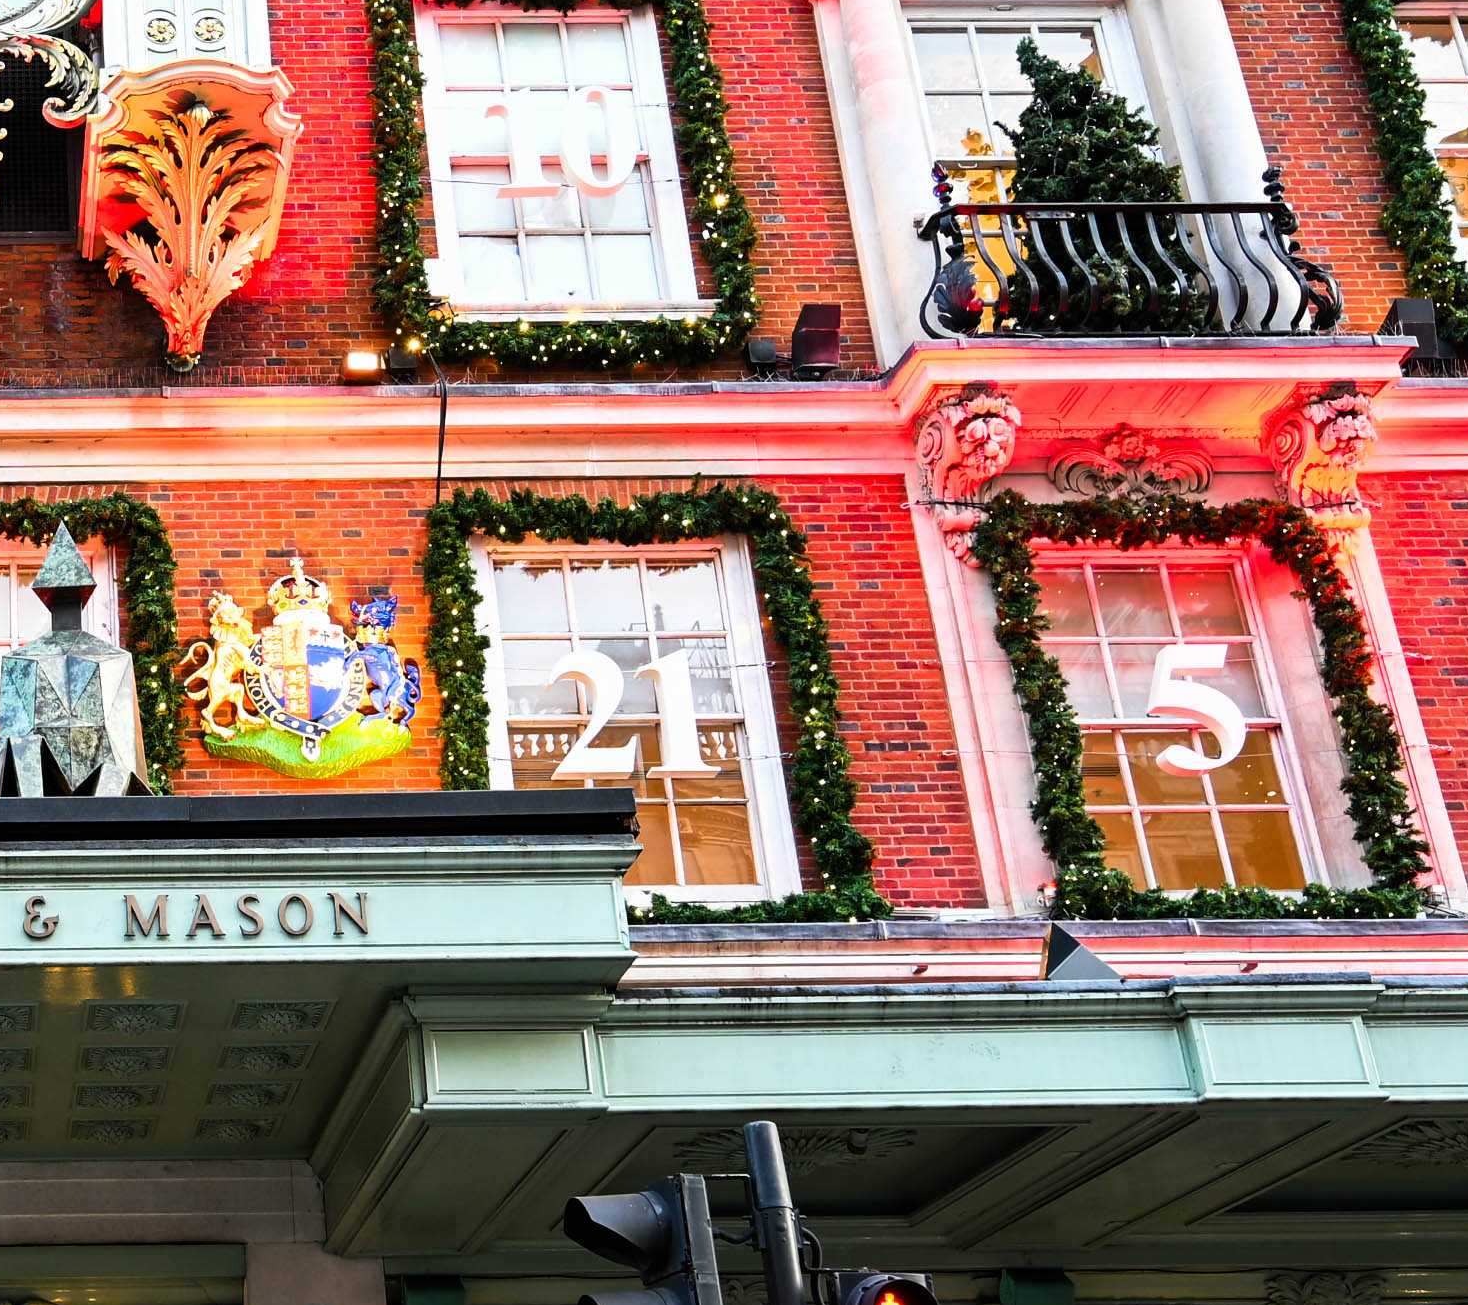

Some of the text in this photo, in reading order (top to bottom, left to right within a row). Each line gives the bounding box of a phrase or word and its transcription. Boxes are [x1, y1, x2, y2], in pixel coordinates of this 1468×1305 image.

[483, 84, 634, 198] 10
[547, 648, 720, 780] 21
[1146, 642, 1246, 776] 5
[22, 895, 60, 940] &
[124, 892, 370, 938] MASON
